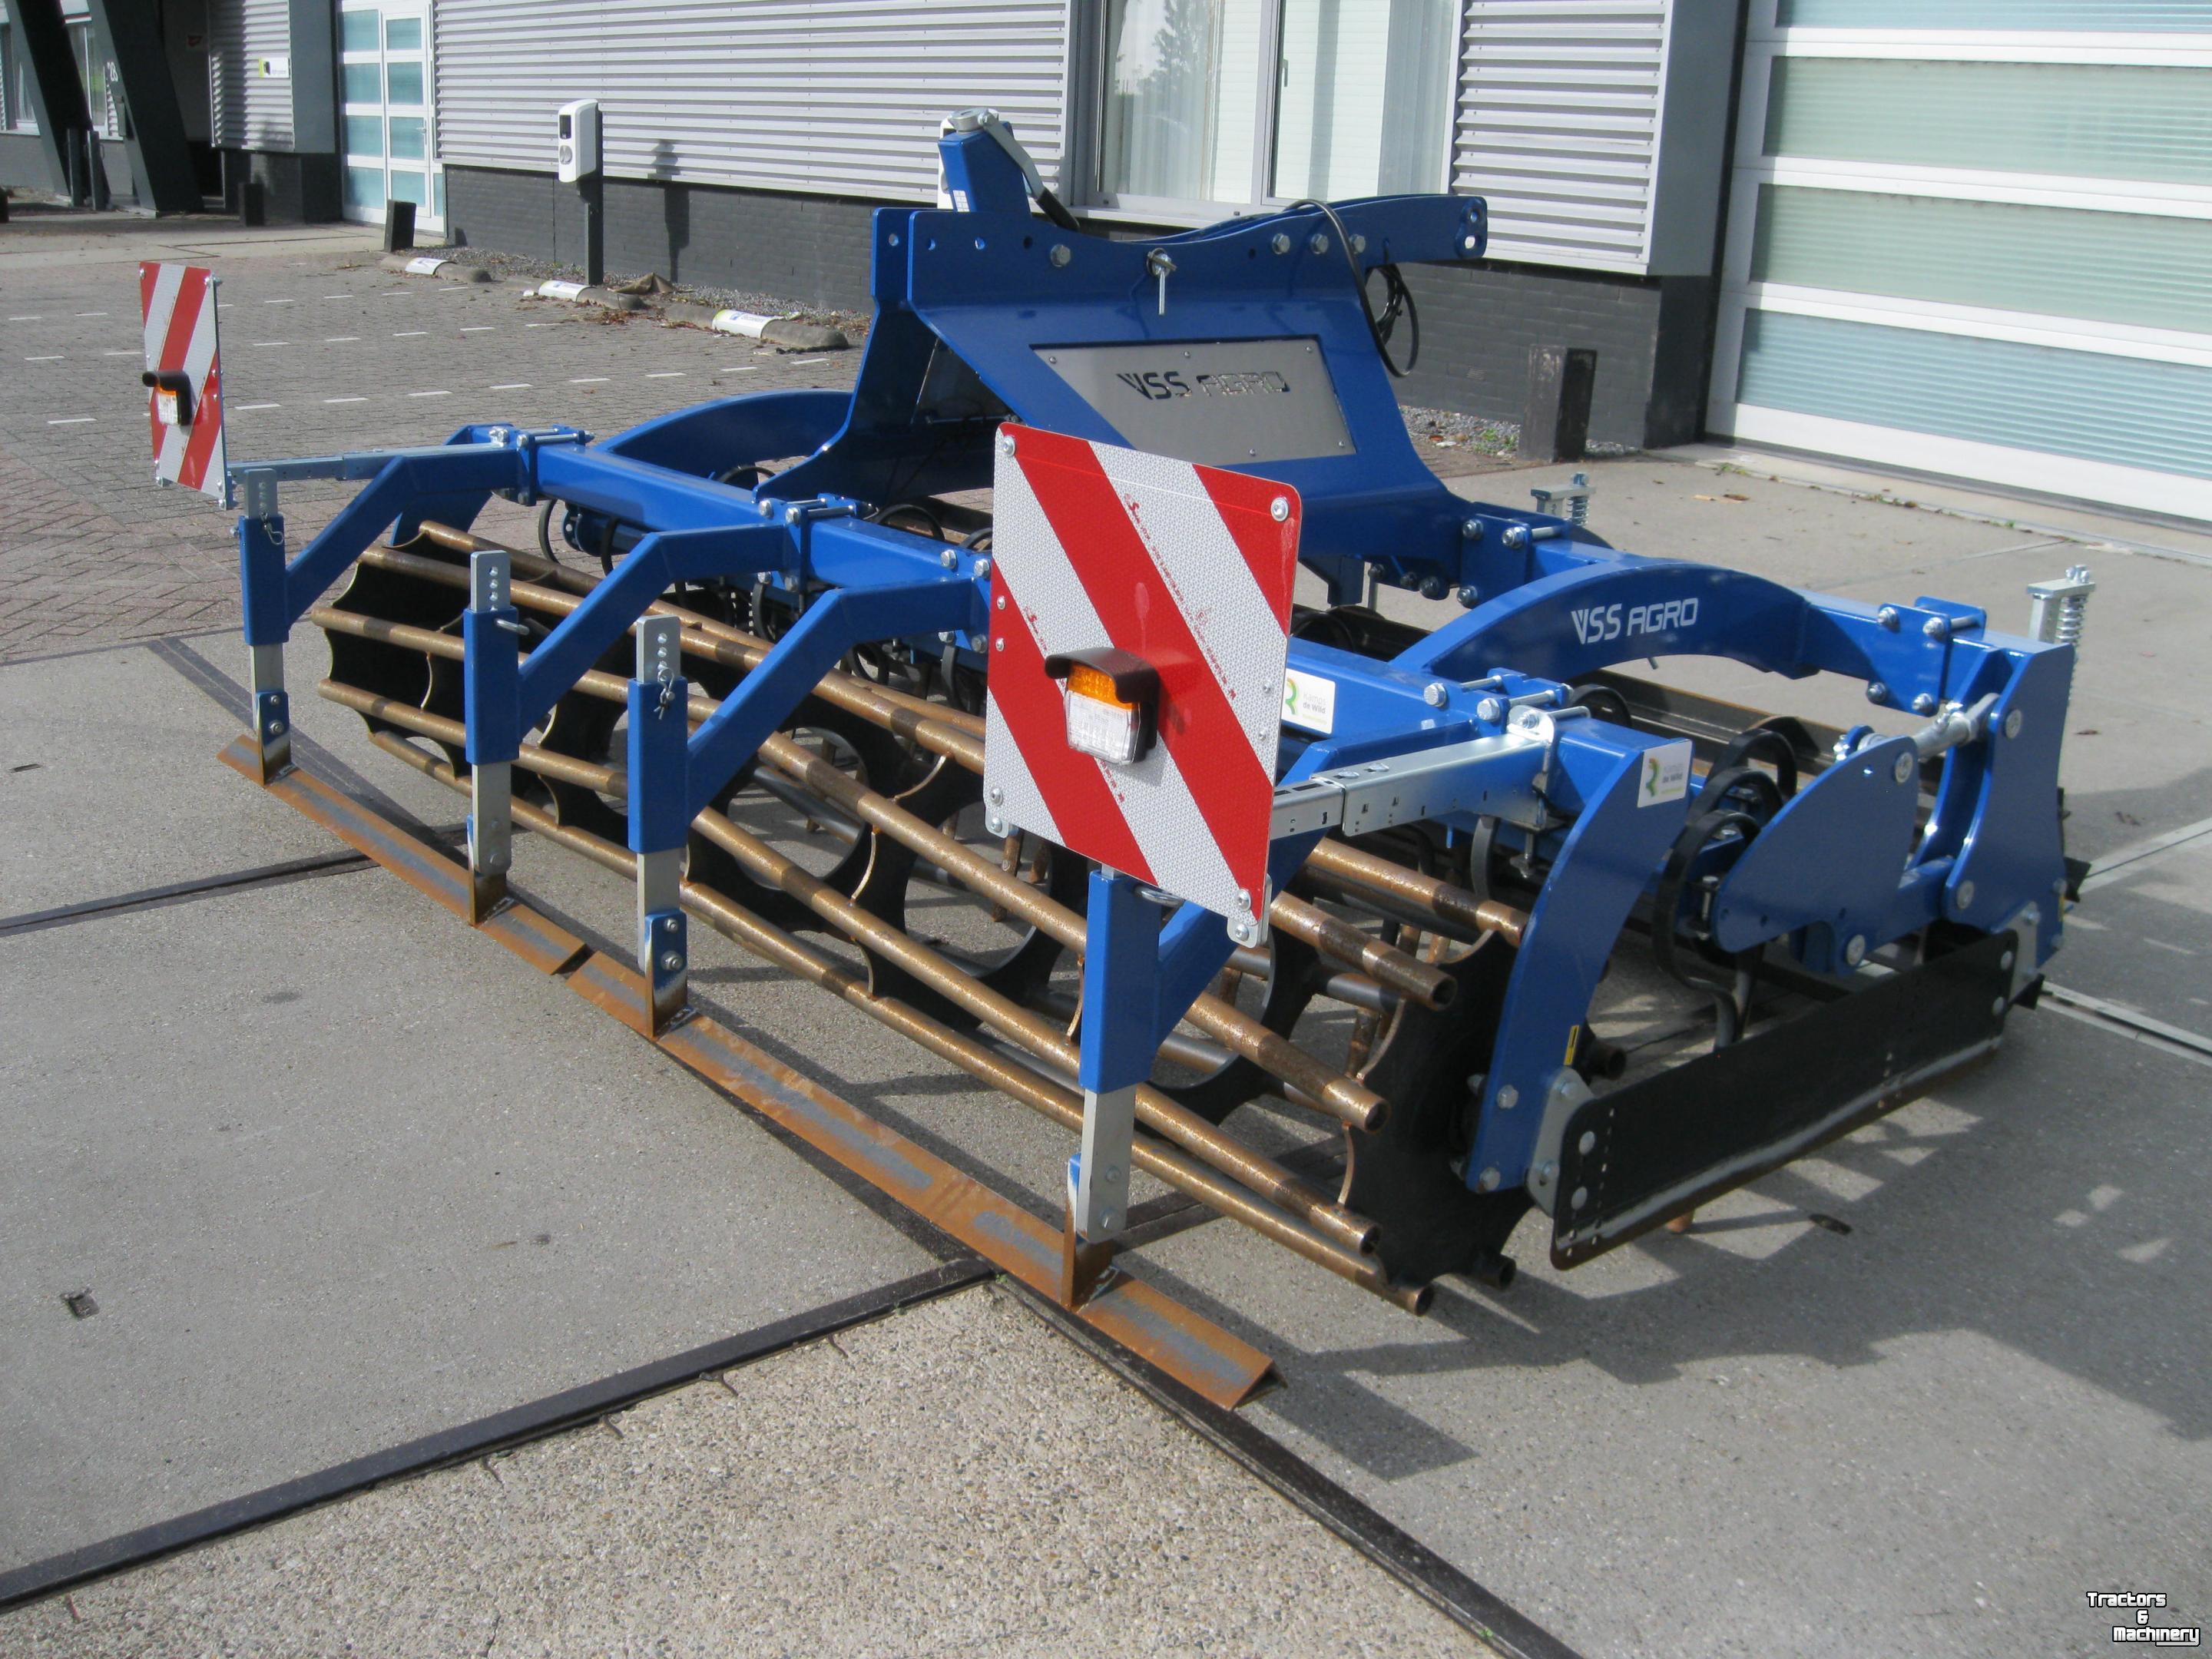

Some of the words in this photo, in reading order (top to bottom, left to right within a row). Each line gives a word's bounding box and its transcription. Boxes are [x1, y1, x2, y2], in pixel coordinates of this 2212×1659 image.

[1116, 370, 1193, 400] VSS
[1571, 603, 1623, 645] VSS
[1626, 597, 1699, 637] AGRO
